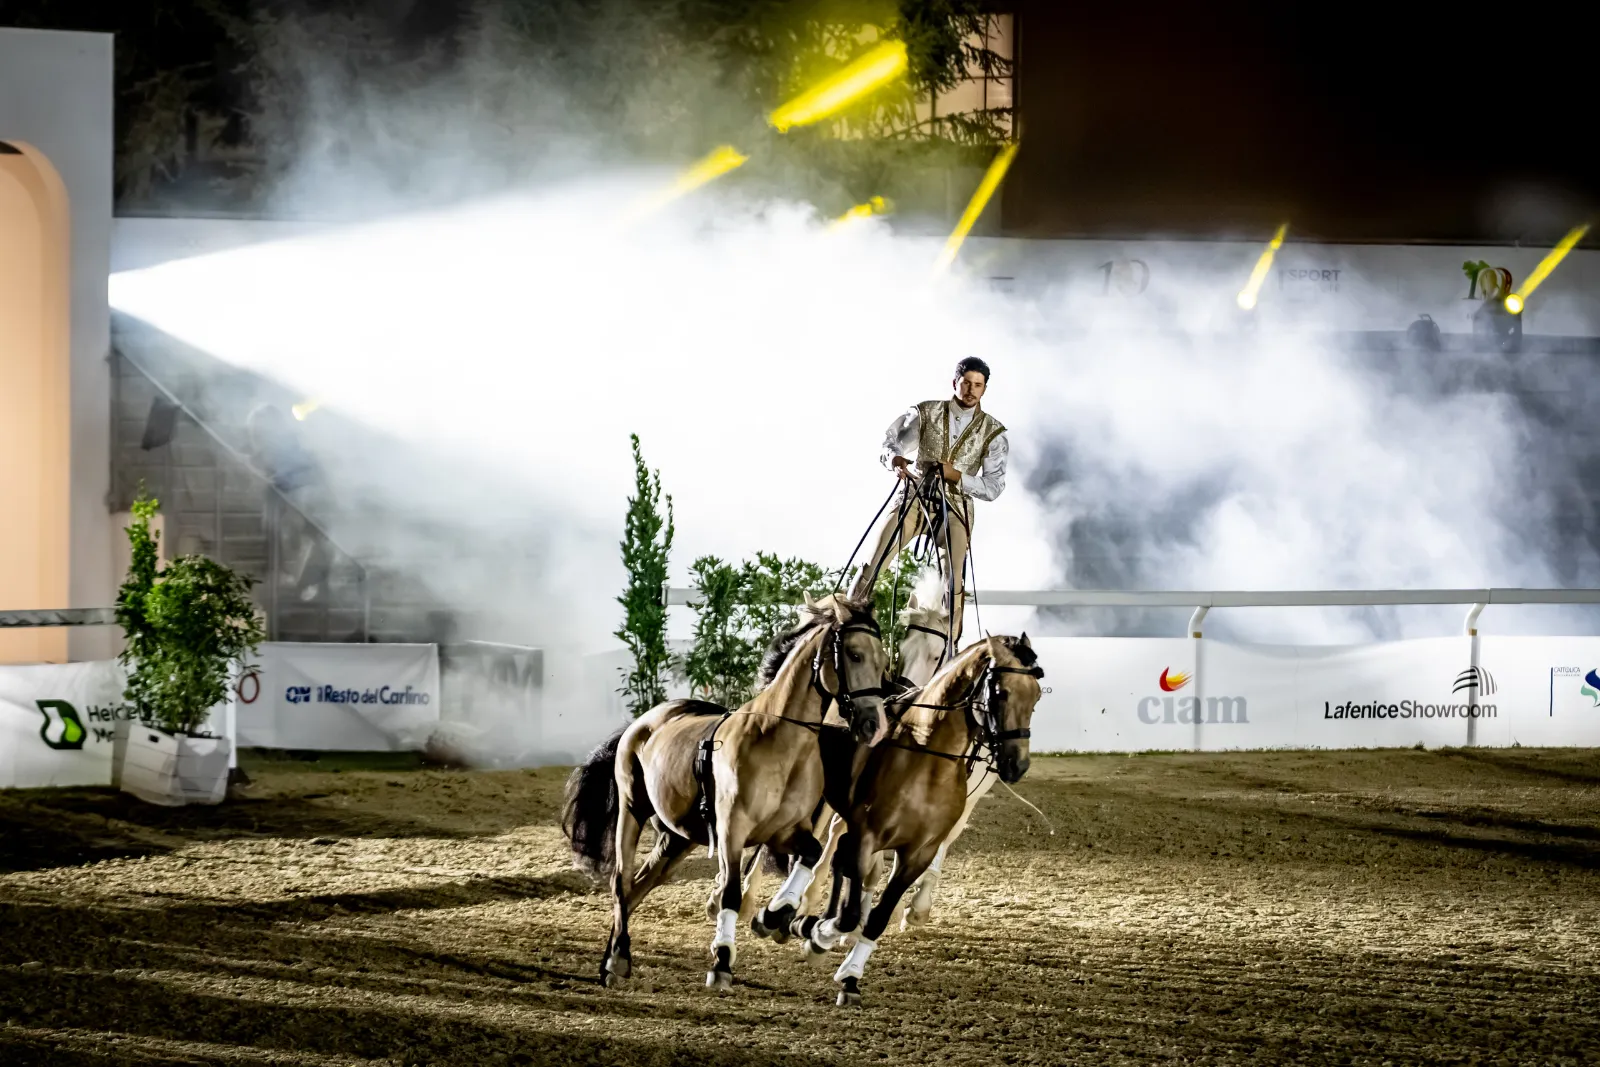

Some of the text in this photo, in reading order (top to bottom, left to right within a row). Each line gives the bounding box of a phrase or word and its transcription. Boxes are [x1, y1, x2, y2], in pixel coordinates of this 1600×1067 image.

[1289, 269, 1341, 281] SPORT
[324, 684, 360, 704] Resto
[361, 687, 378, 704] del
[380, 685, 430, 705] Carlino
[1137, 695, 1250, 725] ciam
[1324, 700, 1498, 720] LafeniceShowroom
